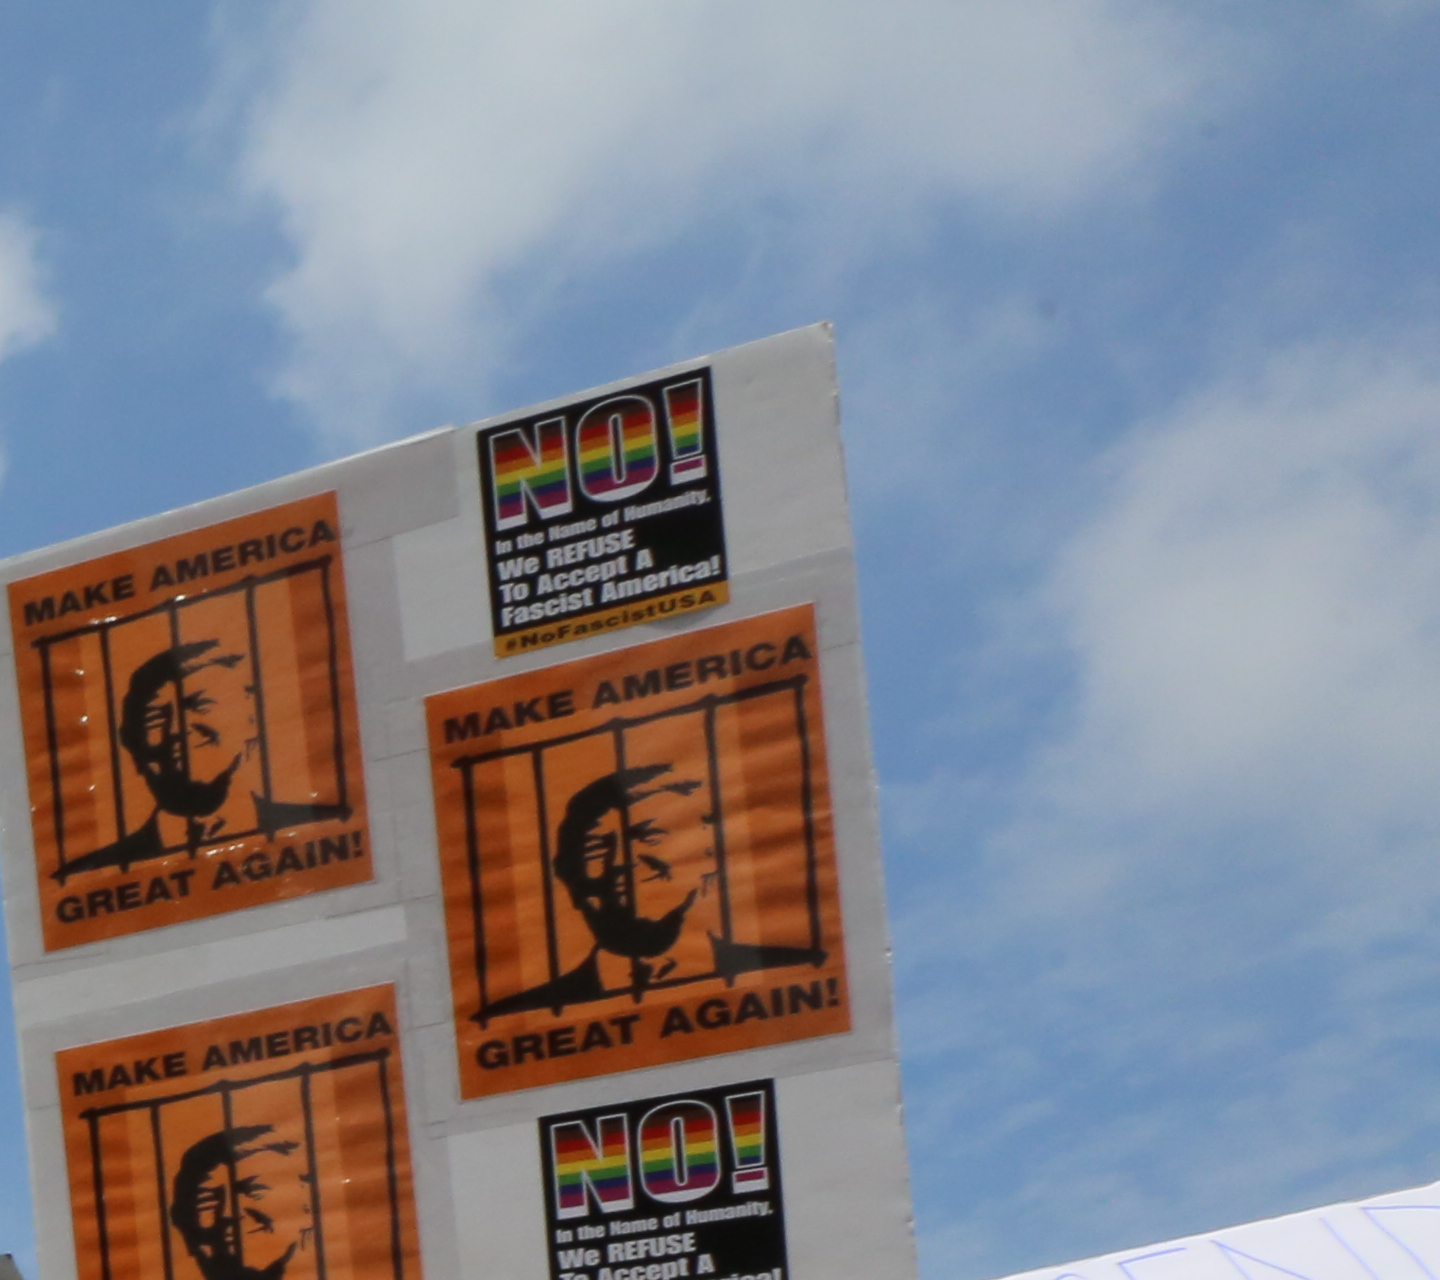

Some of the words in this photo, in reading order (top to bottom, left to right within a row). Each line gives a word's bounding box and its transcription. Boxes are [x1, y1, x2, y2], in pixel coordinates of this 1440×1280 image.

[489, 378, 707, 531] NO!
[497, 557, 540, 581] We
[547, 529, 635, 568] REFUSE
[517, 531, 543, 548] the
[549, 517, 596, 540] Name
[602, 509, 619, 526] of
[24, 574, 135, 626] MAKE
[150, 519, 335, 593] AMERICA
[500, 582, 529, 603] To
[537, 556, 628, 596] Accept
[635, 548, 654, 571] A
[501, 588, 594, 628] Fascist
[600, 554, 721, 603] America!
[506, 589, 717, 652] #NoFascistUSA
[444, 690, 576, 745] MAKE
[592, 633, 812, 710] AMERICA
[54, 868, 195, 924] GREAT
[211, 830, 365, 891] AGAIN!
[73, 1052, 187, 1096] MAKE
[201, 1011, 392, 1072] AMERICA
[475, 1014, 641, 1071] GREAT
[658, 977, 840, 1040] AGAIN!
[550, 1090, 769, 1221] NO!
[556, 1228, 572, 1244] In
[577, 1223, 605, 1240] the
[609, 1215, 658, 1237] Name
[662, 1211, 681, 1228] of
[557, 1247, 600, 1270] We
[608, 1231, 696, 1264] REFUSE
[697, 1253, 715, 1274] A
